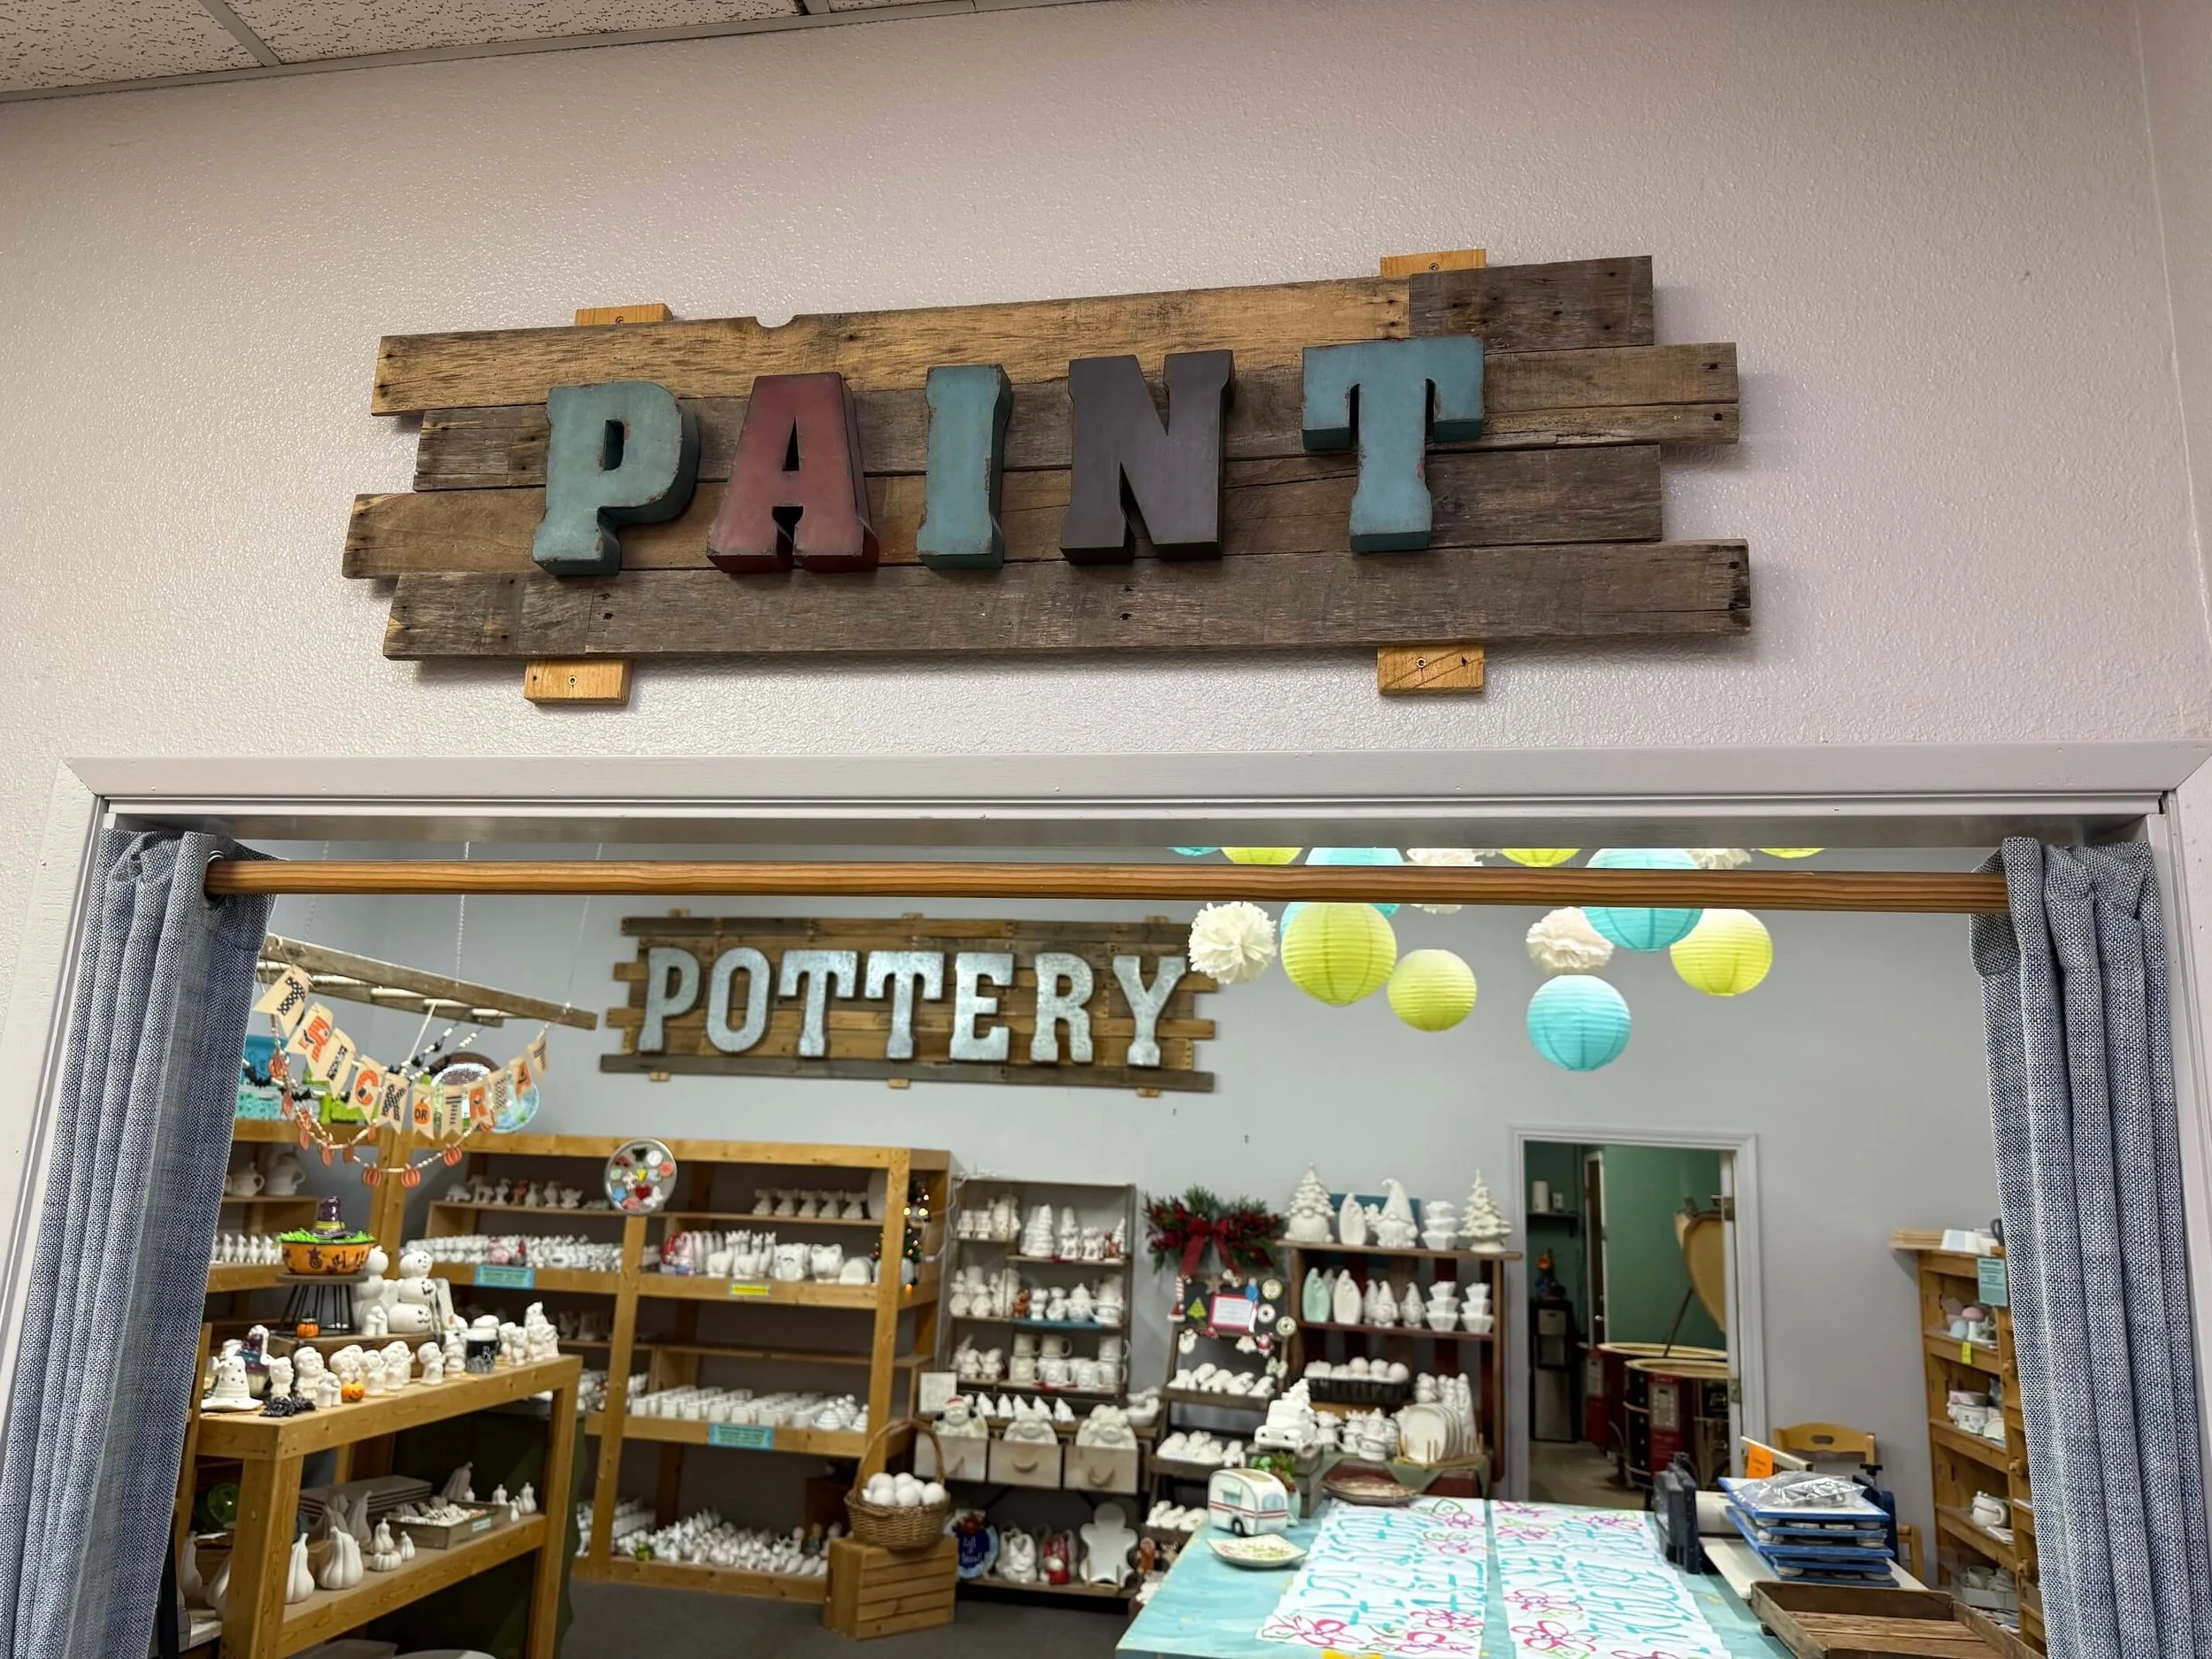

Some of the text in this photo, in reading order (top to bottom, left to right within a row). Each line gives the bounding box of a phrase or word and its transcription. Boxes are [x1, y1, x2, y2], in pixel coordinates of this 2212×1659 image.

[533, 335, 1485, 575] PAINT
[277, 976, 407, 1121] TRICK
[637, 947, 1187, 1066] POTTERY
